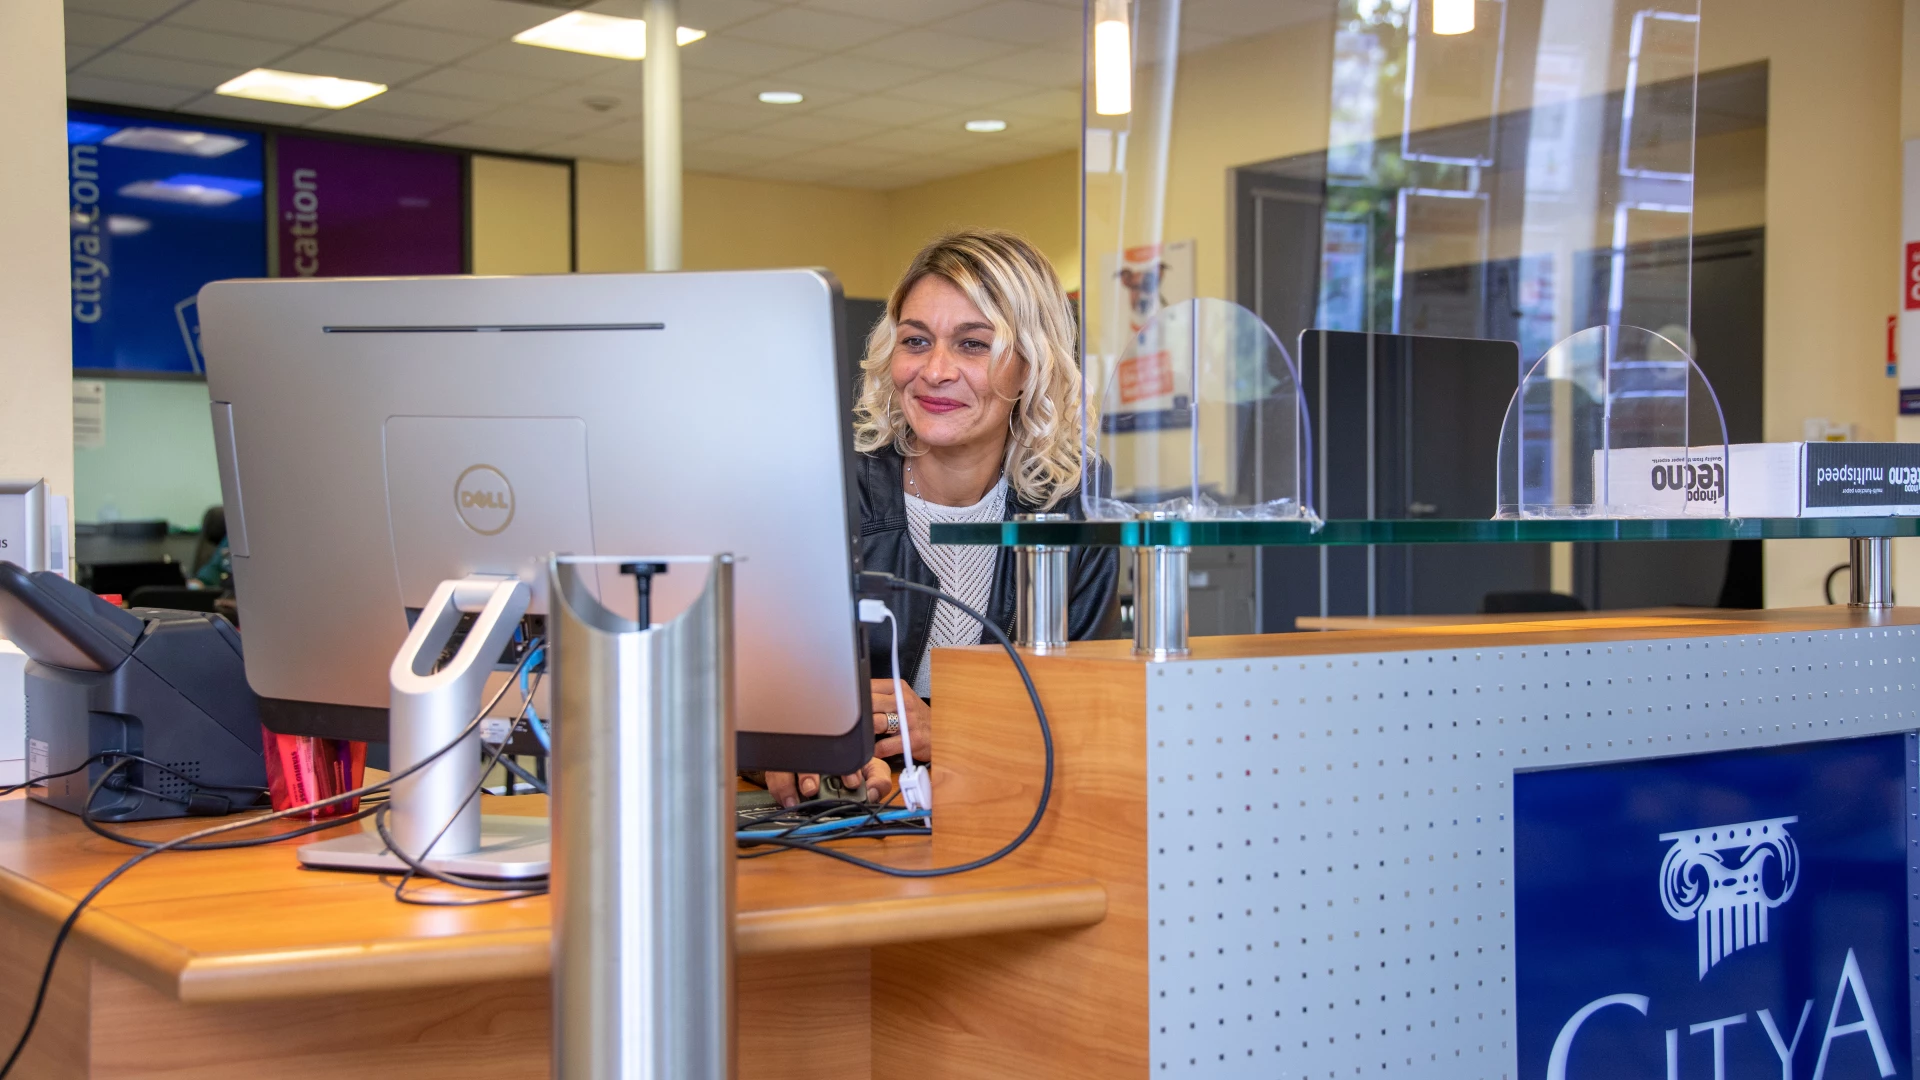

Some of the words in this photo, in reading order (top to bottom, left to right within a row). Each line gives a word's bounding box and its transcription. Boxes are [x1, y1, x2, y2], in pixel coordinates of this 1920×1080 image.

[72, 144, 109, 324] citya.com
[1651, 463, 1724, 498] tecno
[1817, 464, 1883, 486] multispeed
[461, 489, 508, 509] DELL
